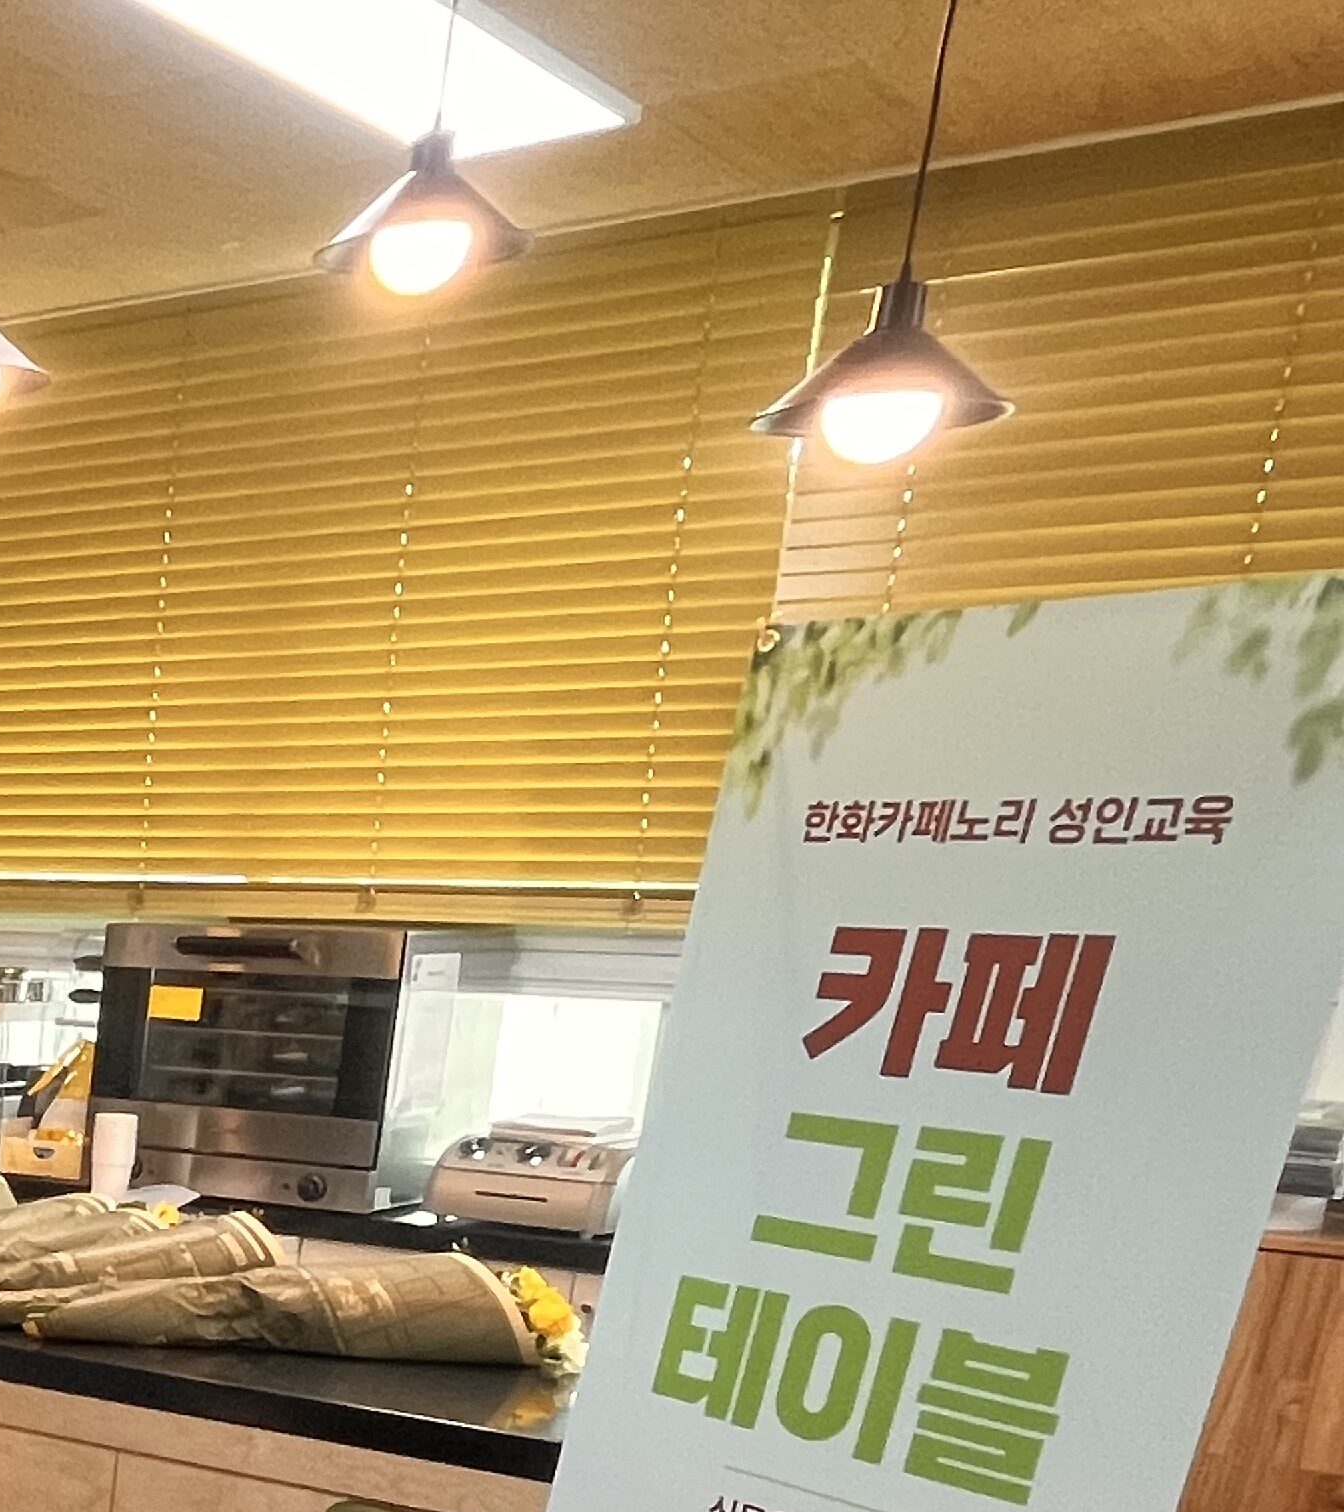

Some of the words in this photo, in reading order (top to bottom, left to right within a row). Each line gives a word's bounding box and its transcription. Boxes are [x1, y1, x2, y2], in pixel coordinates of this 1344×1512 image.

[803, 797, 1037, 844] 한화카페노리
[1047, 794, 1234, 845] 성인교육
[802, 926, 1116, 1096] 카페
[751, 1112, 1053, 1294] 그린
[652, 1274, 1070, 1505] 테이블
